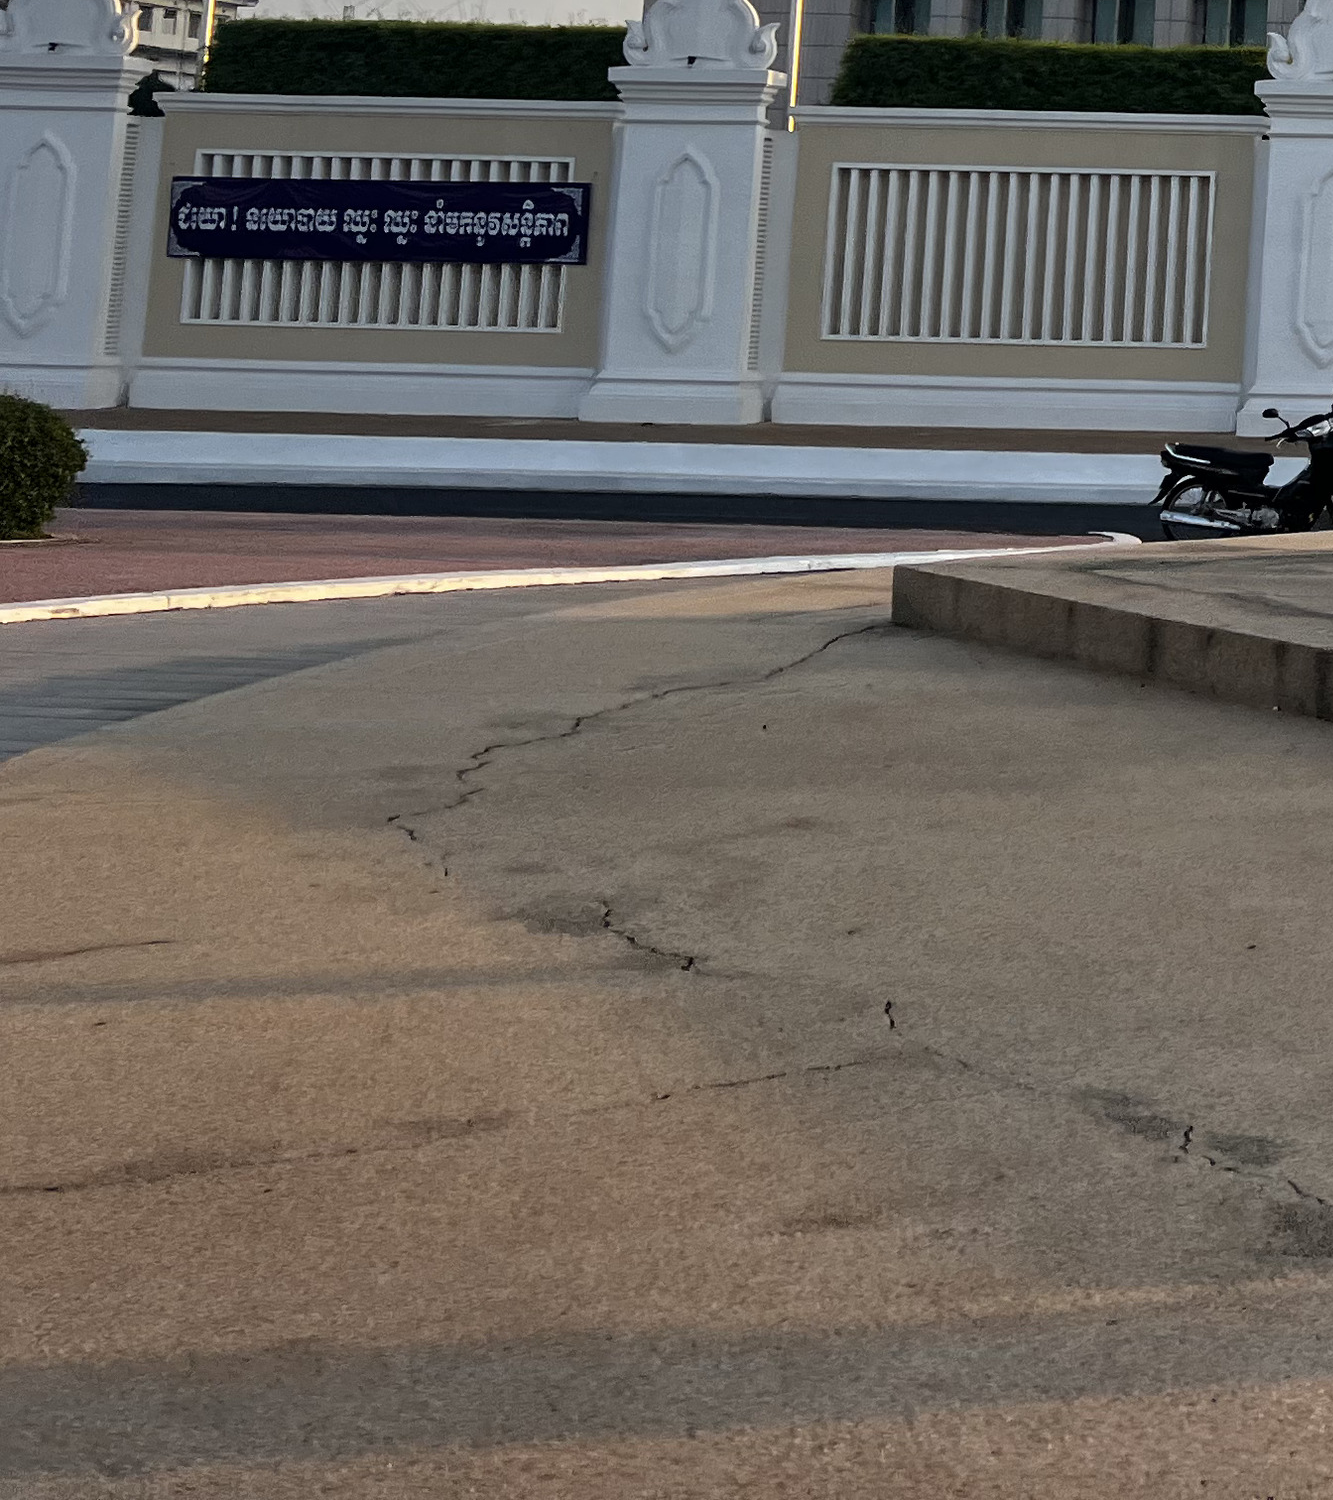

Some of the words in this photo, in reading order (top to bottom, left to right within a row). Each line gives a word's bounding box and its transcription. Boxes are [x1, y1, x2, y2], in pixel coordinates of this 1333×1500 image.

[178, 202, 226, 230] ជយោ
[246, 207, 338, 232] នយោបាយ
